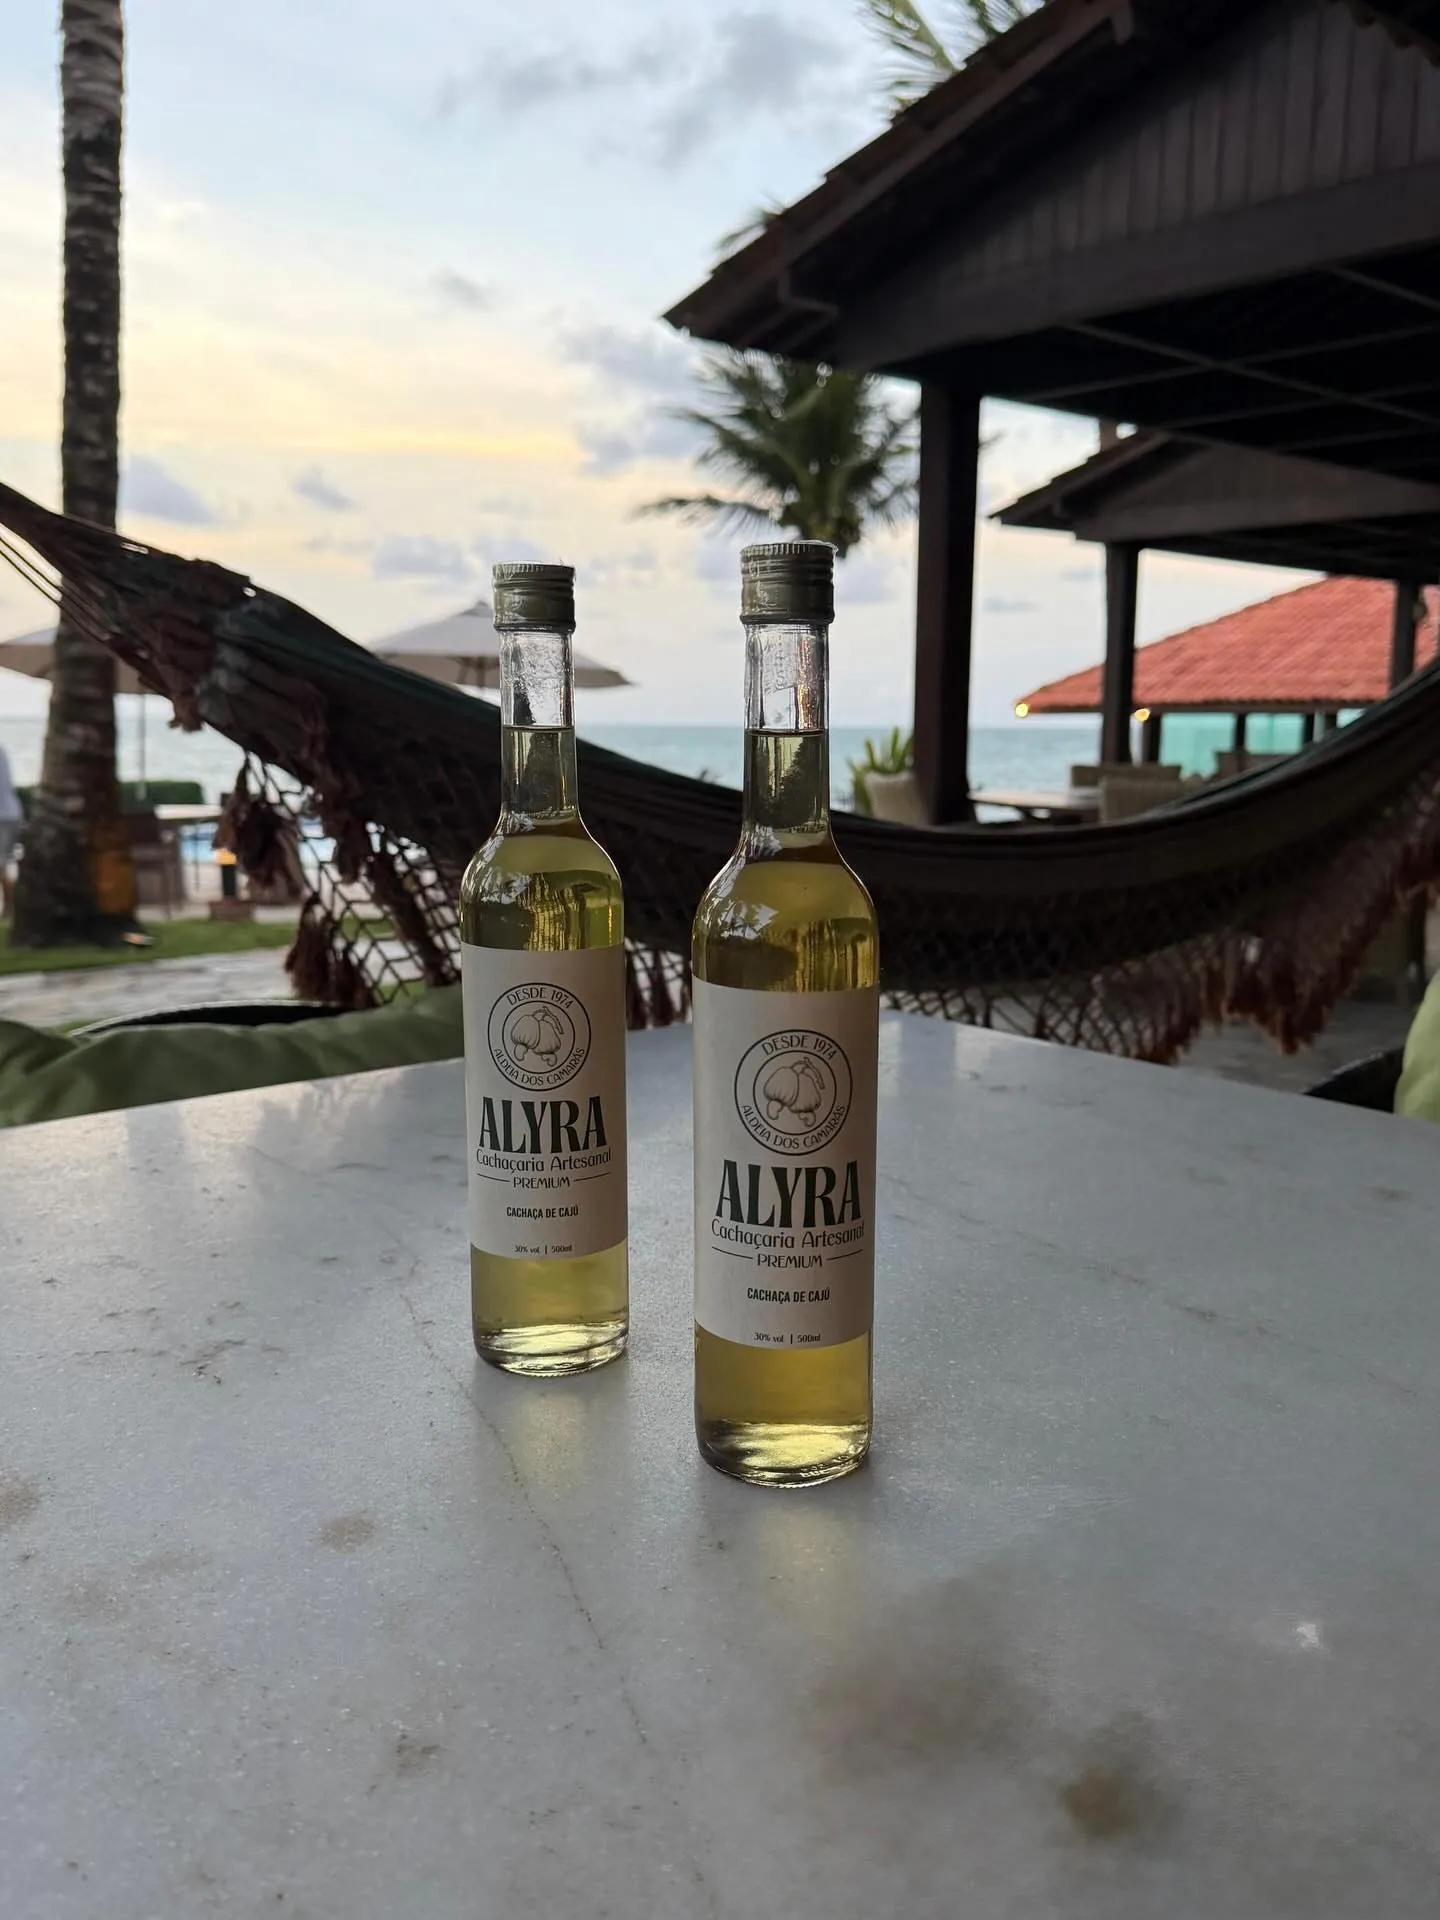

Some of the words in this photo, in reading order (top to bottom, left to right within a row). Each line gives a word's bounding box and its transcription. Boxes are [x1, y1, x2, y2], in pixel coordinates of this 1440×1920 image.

[507, 987, 547, 1006] DESDE
[551, 990, 575, 1009] 1974
[762, 1035, 809, 1056] DESDE
[813, 1038, 838, 1060] 1974
[494, 1047, 519, 1080] ALDEIA
[521, 1073, 544, 1086] DOS
[479, 1095, 607, 1154] ALYRA
[743, 1104, 771, 1142] ALDEIA
[773, 1136, 800, 1149] DOS
[476, 1149, 544, 1174] Cachaçaria
[550, 1148, 611, 1171] Artesanal
[513, 1177, 570, 1189] PREMIUM
[716, 1159, 861, 1228] ALYRA
[506, 1206, 543, 1220] CACHAÇA
[545, 1208, 557, 1218] DE
[559, 1205, 579, 1218] CAJÚ
[711, 1218, 795, 1250] Cachaçaria
[802, 1219, 864, 1249] Artesanal
[757, 1253, 823, 1268] PREMIUM
[747, 1287, 790, 1304] CACHAÇA
[793, 1291, 806, 1302] DE
[808, 1286, 830, 1302] CAJÚ
[753, 1332, 771, 1342] 30%
[772, 1334, 785, 1343] vol
[797, 1333, 821, 1343] 500ml
